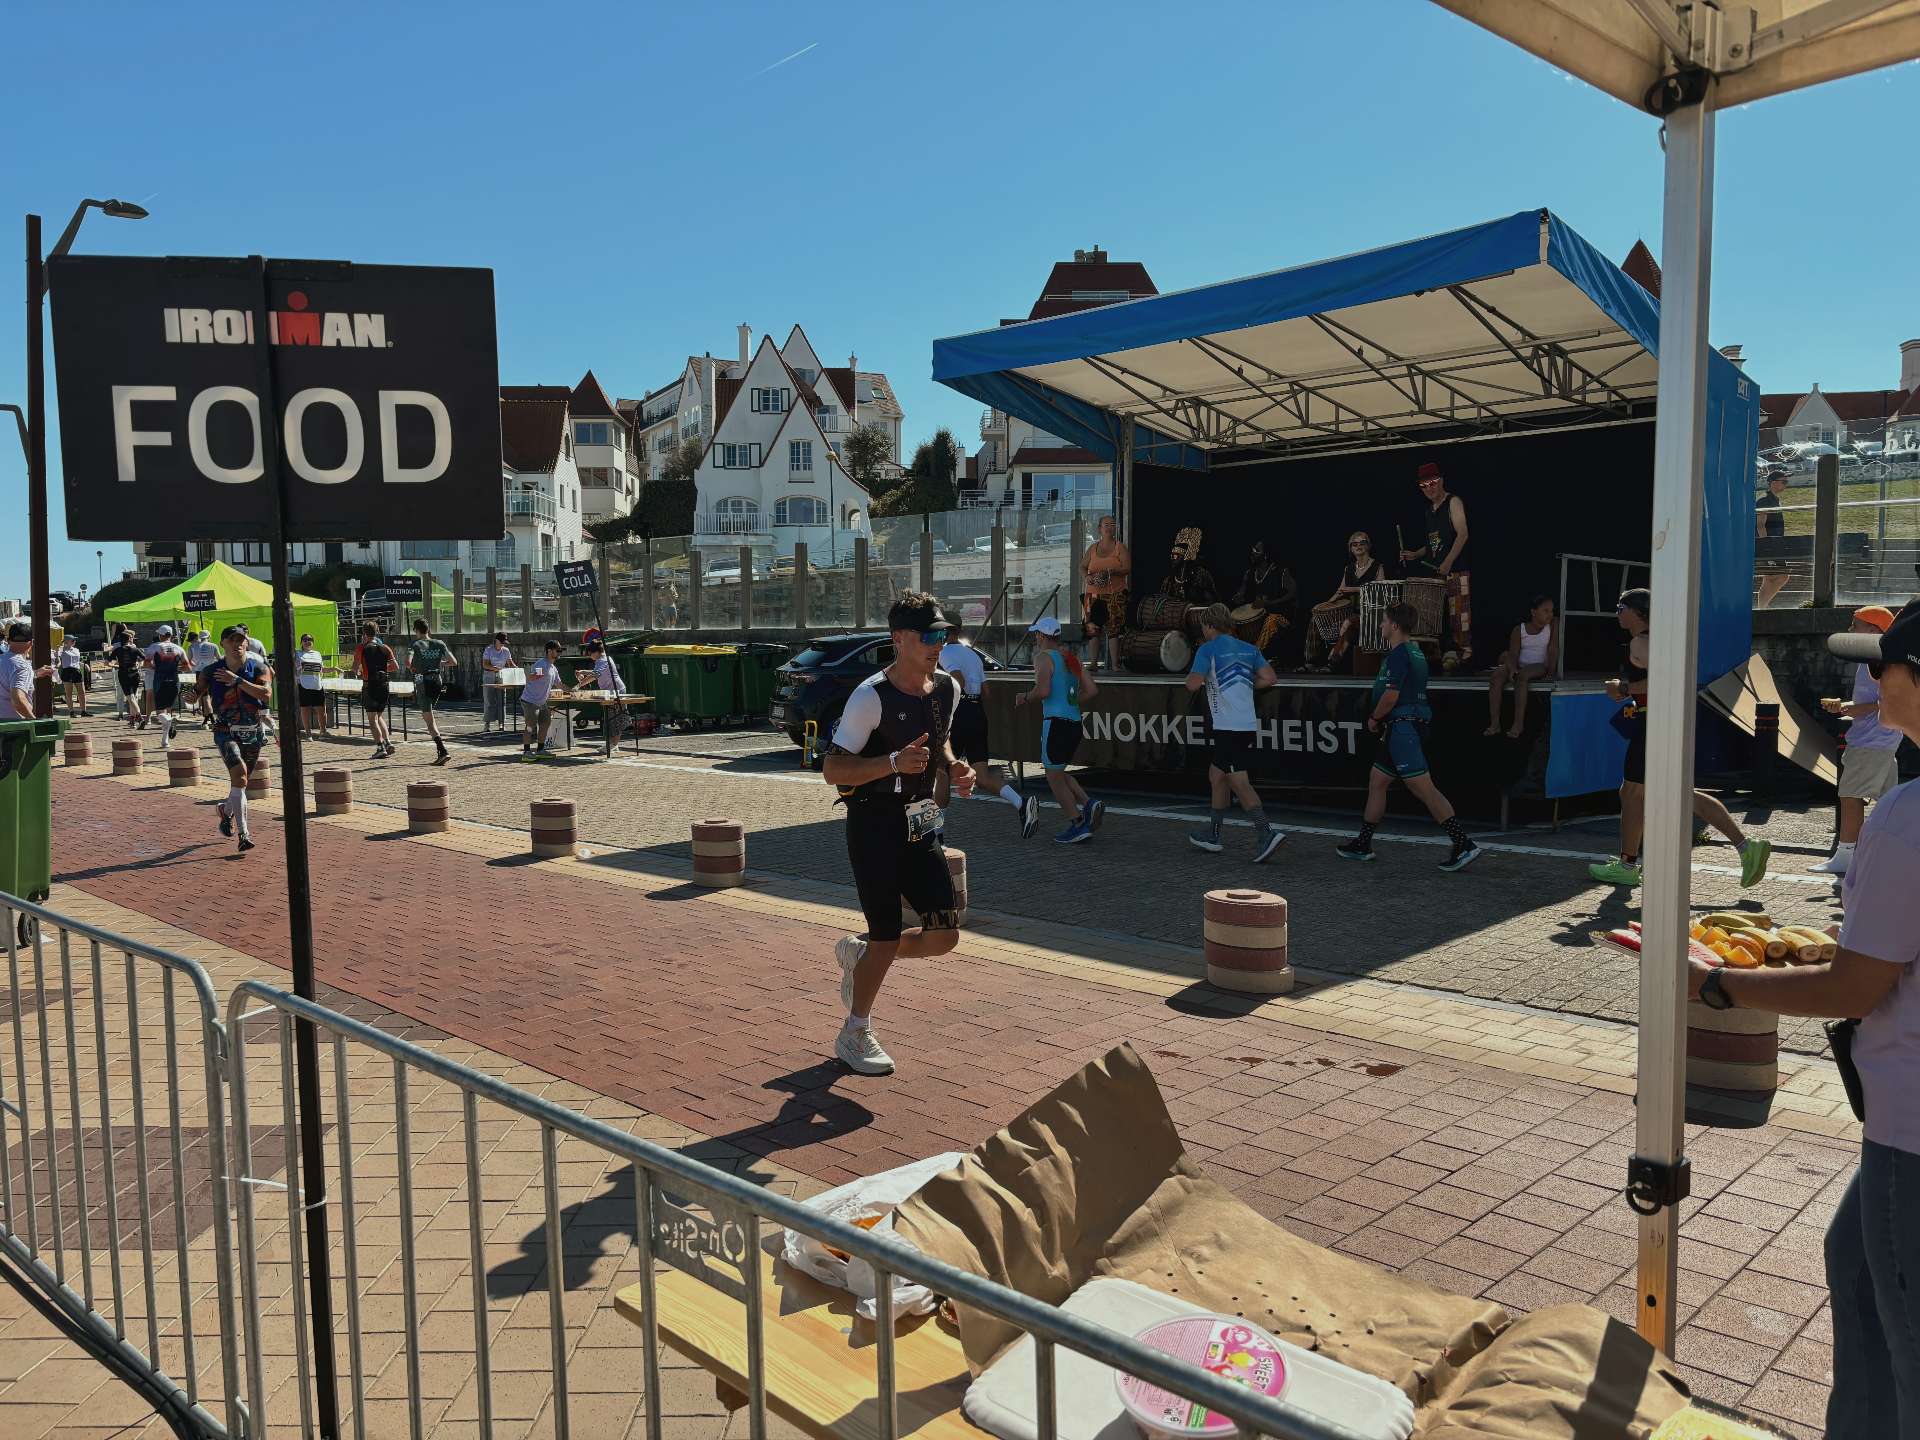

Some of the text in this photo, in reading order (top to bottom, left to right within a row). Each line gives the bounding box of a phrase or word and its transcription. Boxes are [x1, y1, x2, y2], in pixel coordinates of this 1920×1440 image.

[112, 385, 452, 484] FOOD
[563, 574, 592, 589] COLA
[185, 599, 216, 608] WATER
[1256, 717, 1363, 754] HEIST
